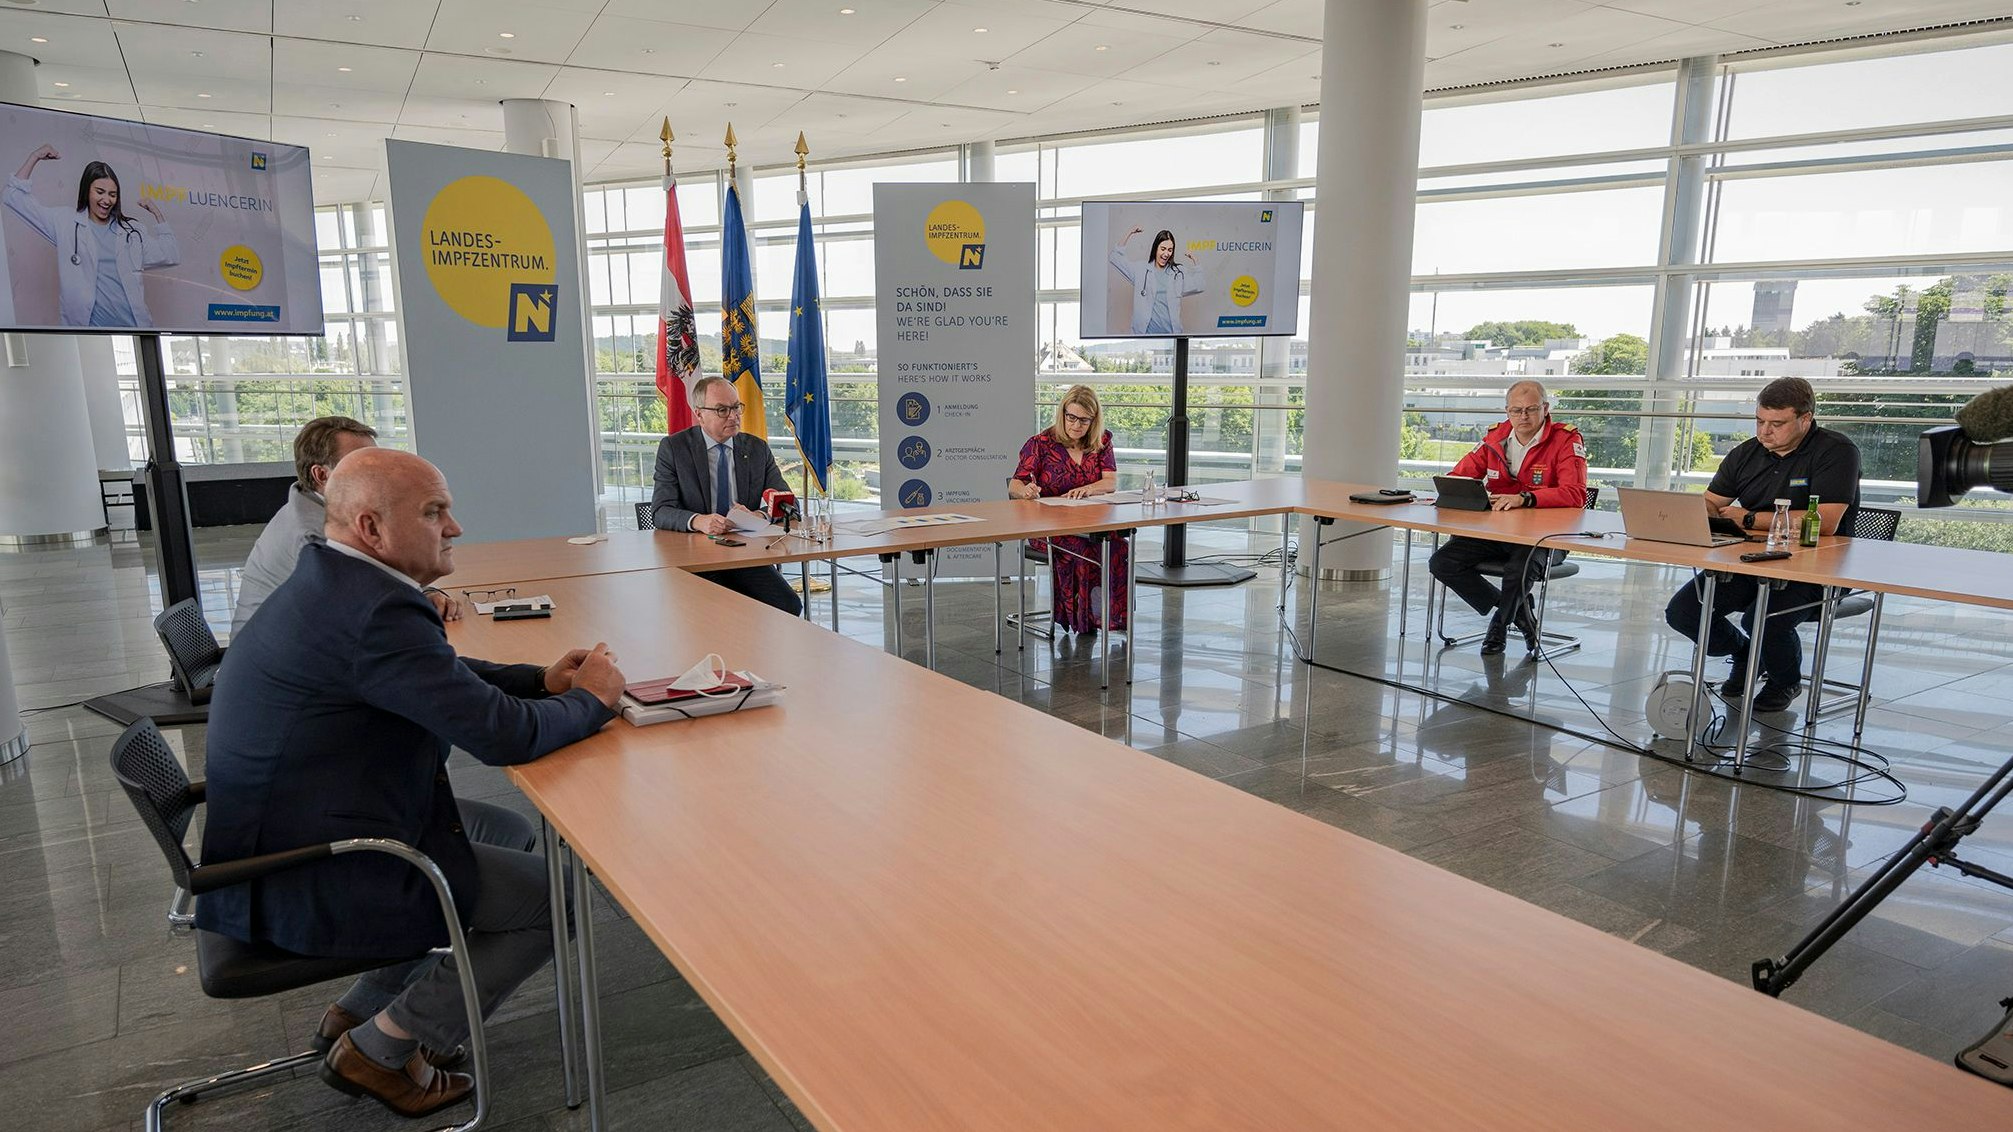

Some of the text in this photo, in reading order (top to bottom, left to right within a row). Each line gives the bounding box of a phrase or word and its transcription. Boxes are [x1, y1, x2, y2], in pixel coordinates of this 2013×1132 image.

[928, 224, 960, 232] LANDES-
[430, 230, 502, 249] LANDES-
[928, 231, 982, 239] IMPFZENTRUM.
[234, 256, 249, 265] Jetzt
[432, 250, 549, 271] IMPFZENTRUM.
[224, 261, 258, 275] Impftermin
[229, 270, 253, 280] buchen!
[896, 285, 993, 299] SCHÖN, DASS SIE
[896, 301, 946, 313] DA SIND!
[214, 308, 274, 319] www.impfung.at
[896, 315, 1009, 327] WE'RE GLAD YOU'RE
[897, 331, 929, 342] HERE!
[897, 362, 978, 371] SO FUNKTIONIERT'S
[897, 373, 992, 383] HERE'S HOW IT WORKS
[937, 405, 941, 414] 1
[936, 448, 943, 458] 2
[937, 491, 943, 501] 3
